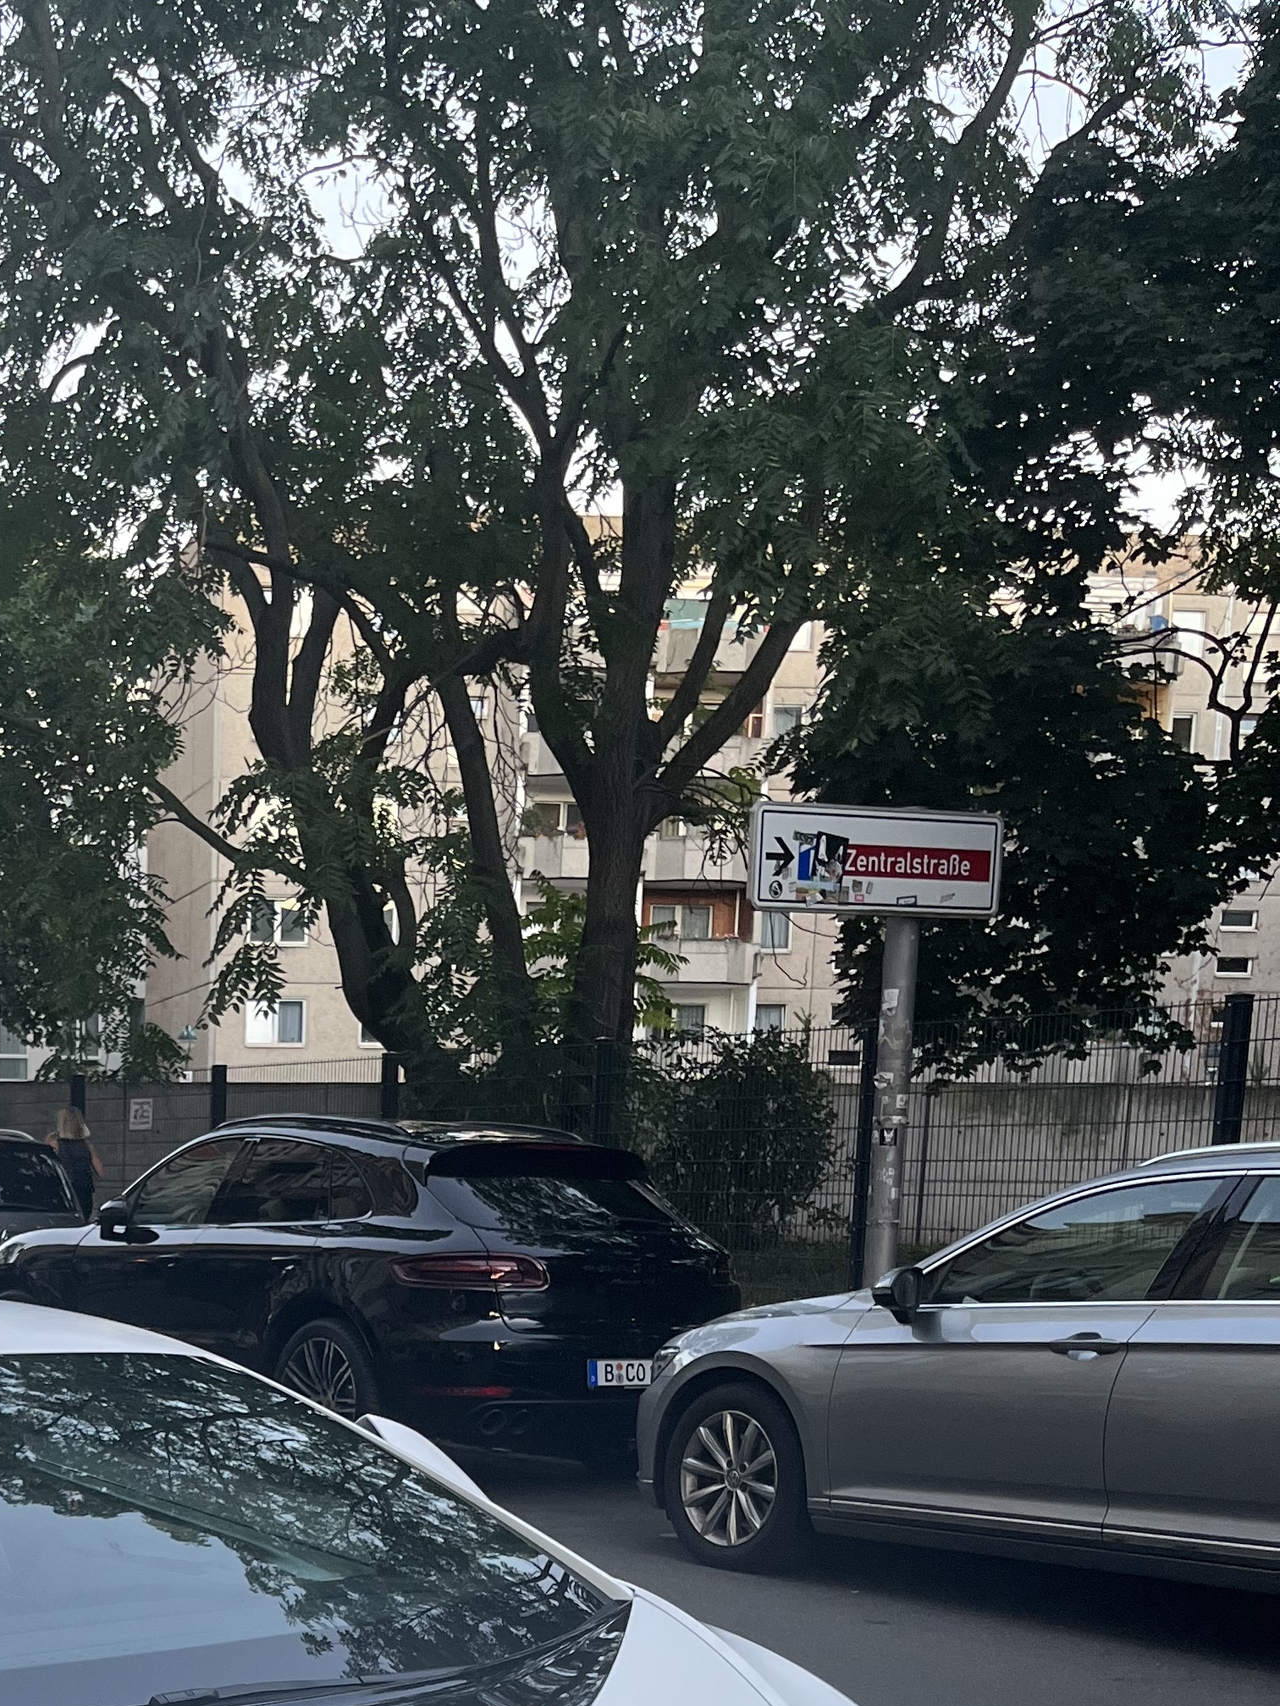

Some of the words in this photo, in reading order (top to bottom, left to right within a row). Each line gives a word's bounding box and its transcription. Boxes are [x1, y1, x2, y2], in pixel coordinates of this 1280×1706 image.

[845, 849, 970, 876] Zentralstraße
[605, 1363, 614, 1382] B
[626, 1363, 645, 1382] CO
